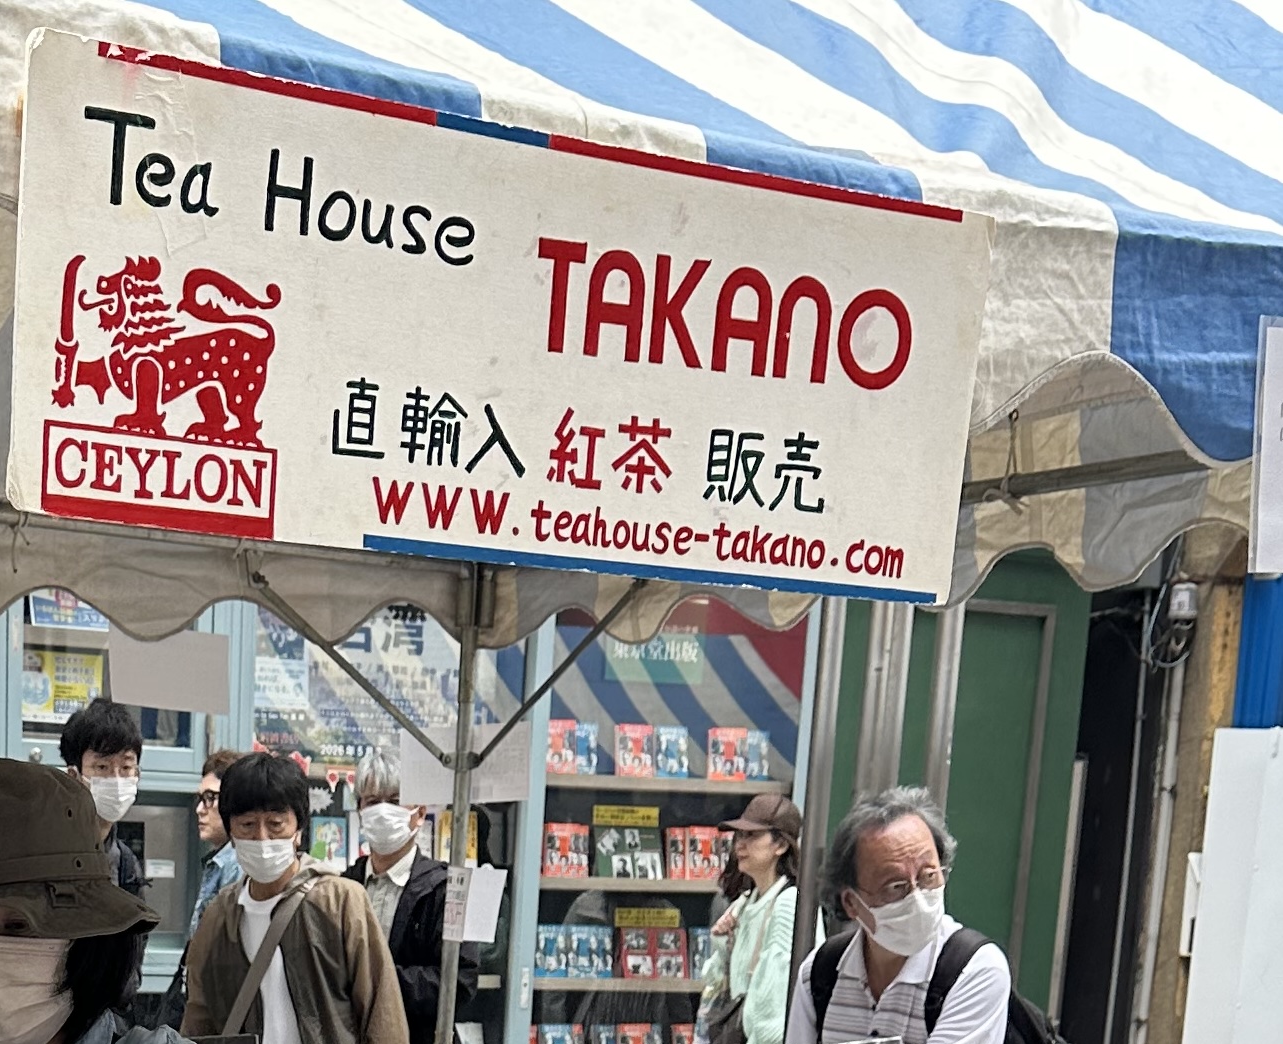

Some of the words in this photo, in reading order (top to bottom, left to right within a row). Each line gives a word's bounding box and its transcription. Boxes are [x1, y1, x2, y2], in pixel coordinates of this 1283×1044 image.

[83, 105, 218, 218] Tea
[264, 147, 476, 266] House
[538, 237, 913, 390] TAKANO
[54, 437, 268, 508] CEYLON
[331, 377, 526, 479] 直輸入
[546, 407, 673, 494] 紅茶
[702, 428, 825, 514] 販売
